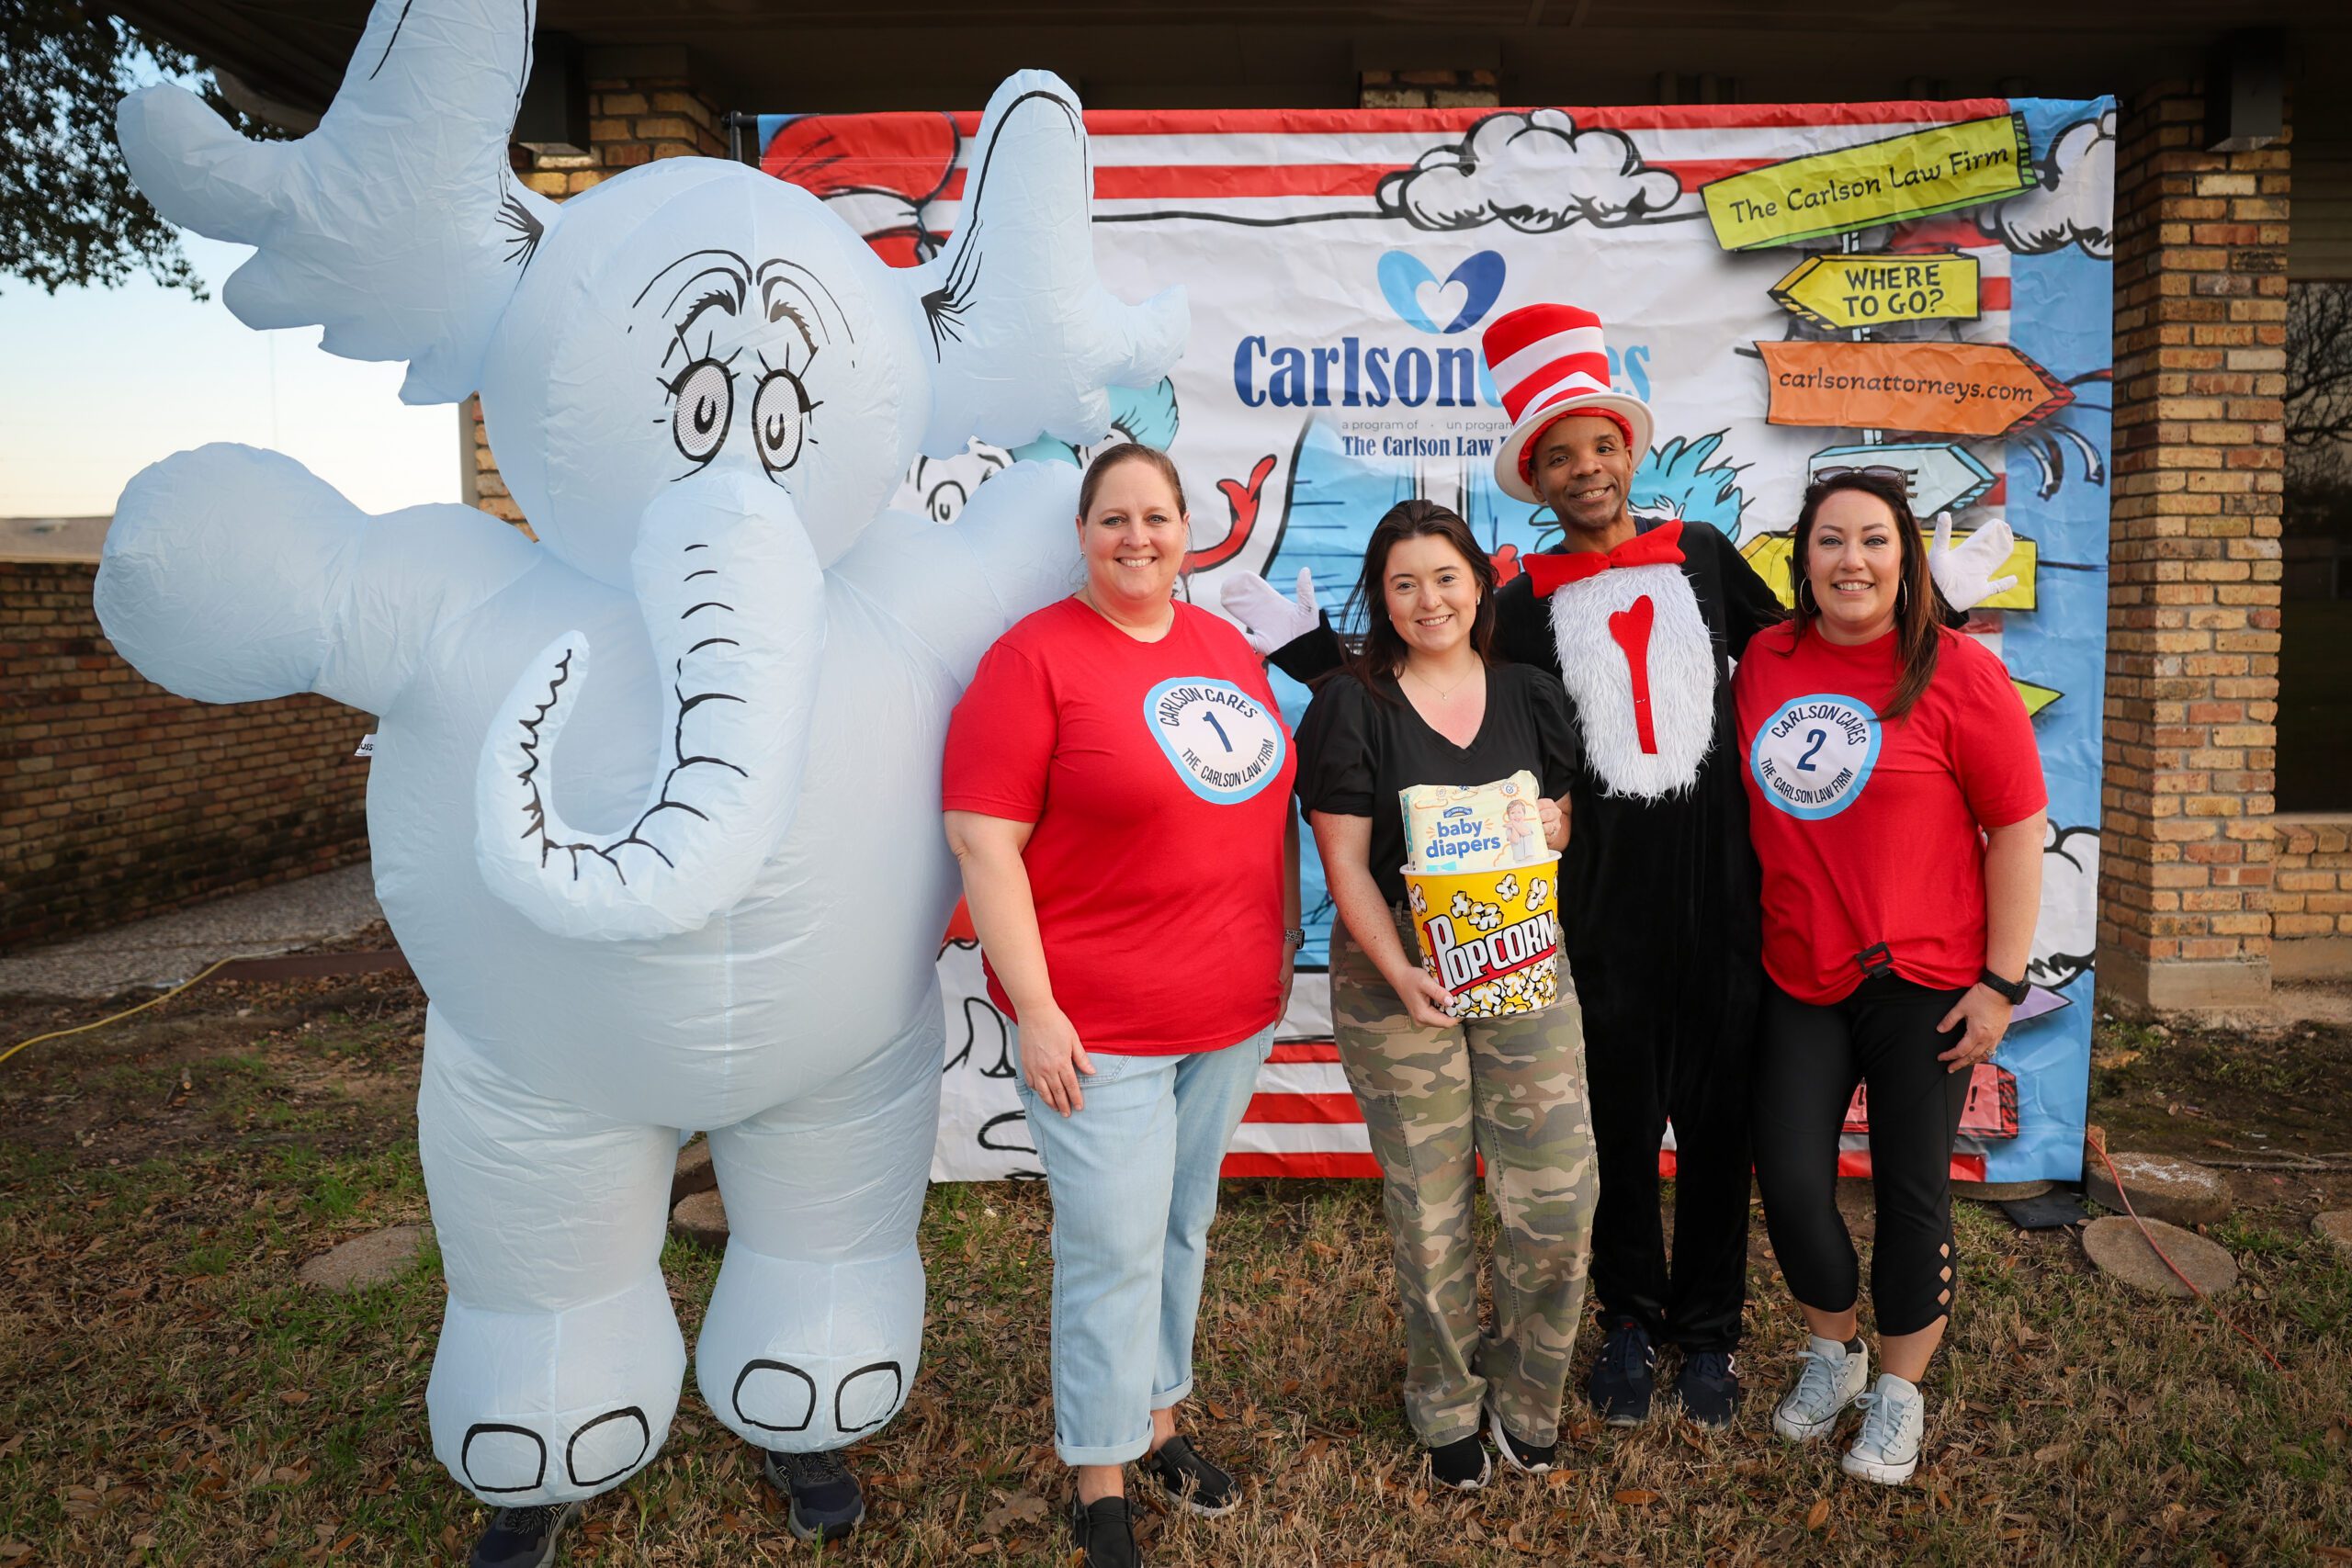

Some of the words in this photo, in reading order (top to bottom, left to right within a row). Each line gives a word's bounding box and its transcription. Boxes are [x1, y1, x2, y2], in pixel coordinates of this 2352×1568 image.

[1730, 199, 1778, 224] The
[1787, 175, 1882, 212] Carlson
[1889, 164, 1941, 188] Law
[1949, 145, 2009, 176] Firm
[1844, 264, 1941, 291] WHERE
[1842, 295, 1880, 318] TO
[1887, 289, 1944, 315] GO?
[1779, 368, 2033, 403] carlsonattorneys.com
[1341, 421, 1349, 430] a
[1351, 421, 1404, 433] program
[1407, 420, 1419, 430] of
[1446, 421, 1462, 430] un
[1342, 436, 1376, 457] The
[1383, 436, 1450, 457] Carlson
[1456, 436, 1494, 457] Law
[1159, 687, 1204, 727] CARLSON
[1204, 688, 1259, 718] CARES
[1771, 705, 1840, 739] CARLSON
[1836, 711, 1867, 746] CARES
[1202, 711, 1233, 753] 1
[1796, 728, 1827, 772] 2
[1182, 748, 1202, 772] THE
[1200, 765, 1241, 787] CARLSON
[1241, 761, 1261, 784] LAW
[1257, 739, 1274, 766] FIRM
[1760, 757, 1777, 780] THE
[1773, 776, 1814, 804] CARLSON
[1814, 784, 1835, 804] LAW
[1831, 767, 1854, 793] FIRM
[1426, 834, 1501, 859] diapers
[1436, 818, 1483, 840] baby
[1424, 909, 1555, 992] POPCORN
